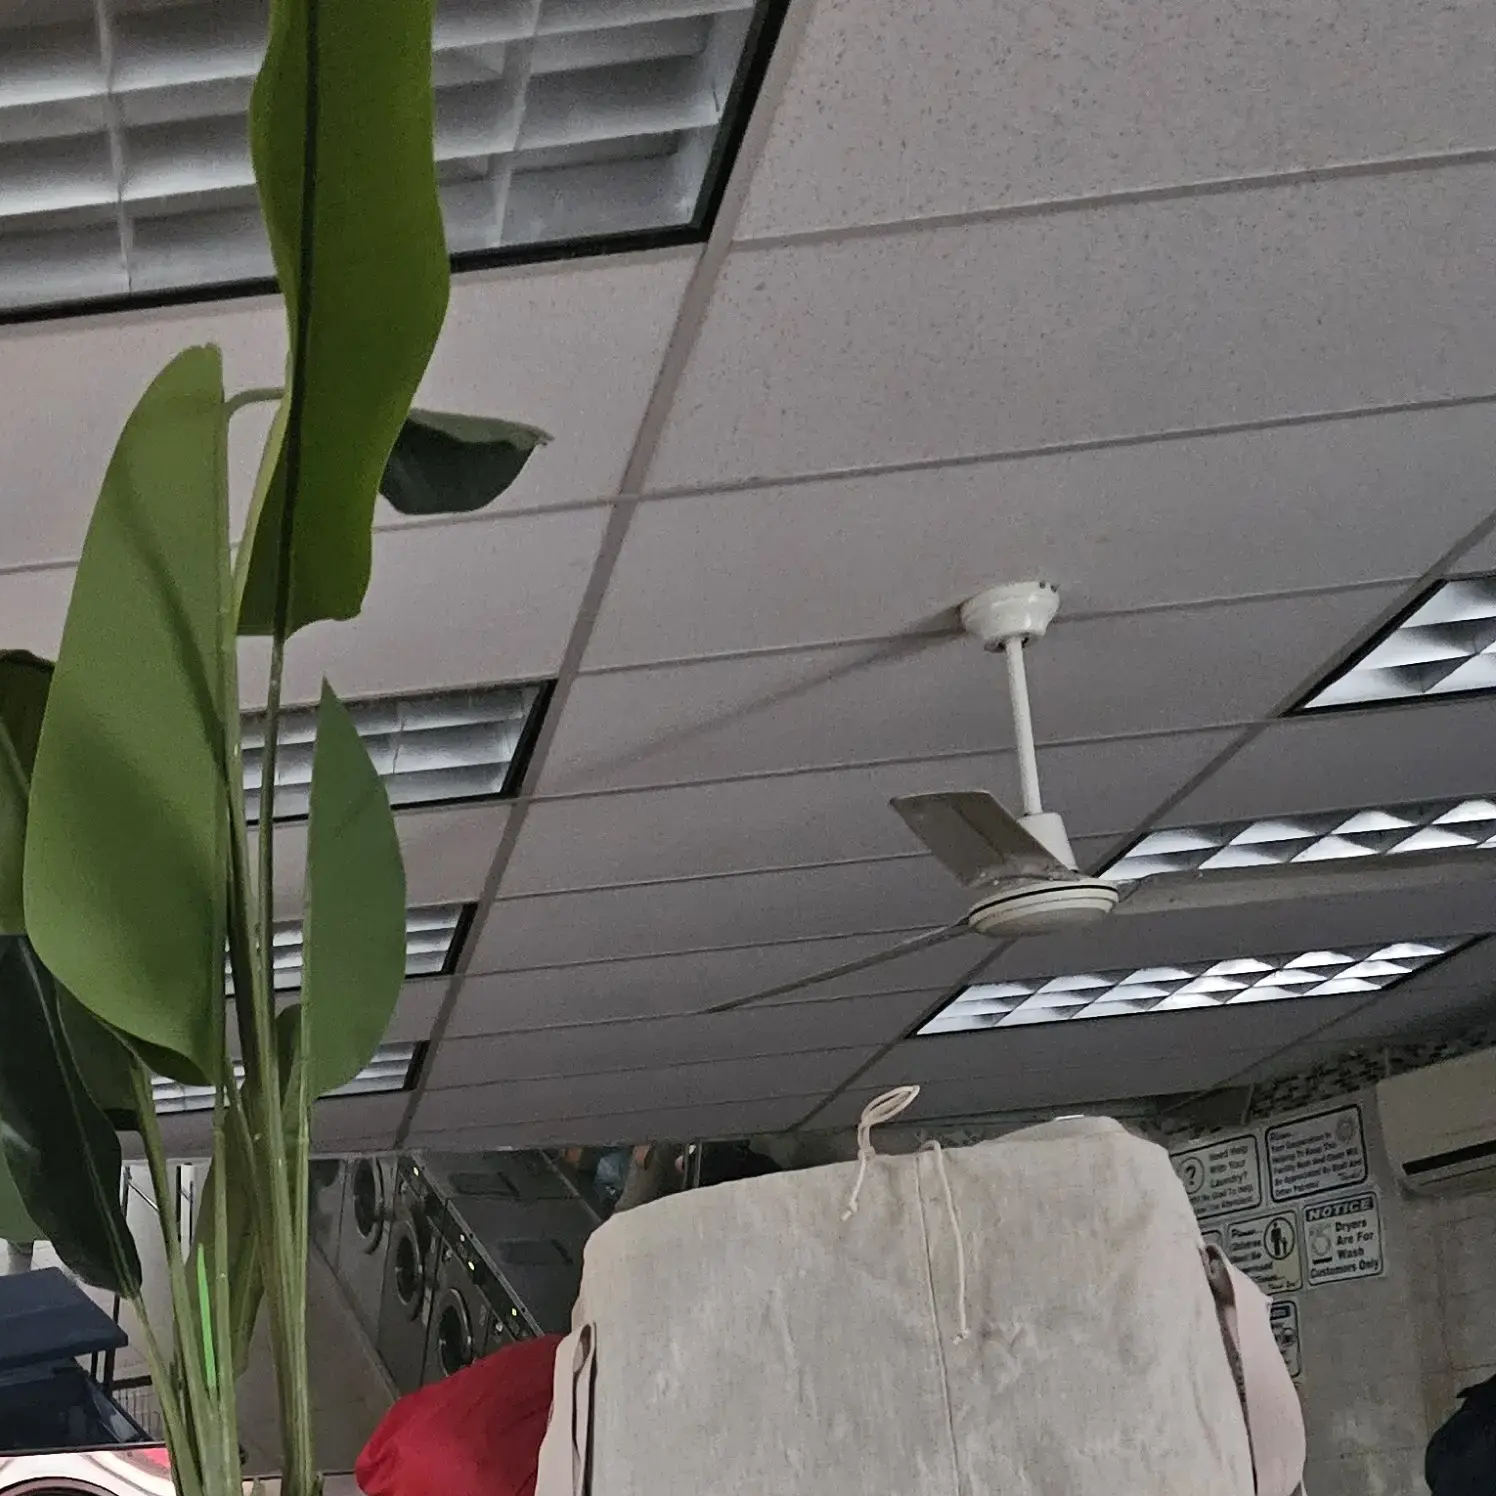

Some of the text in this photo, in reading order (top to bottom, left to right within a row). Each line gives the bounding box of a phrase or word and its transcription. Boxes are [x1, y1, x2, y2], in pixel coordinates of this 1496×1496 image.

[1307, 1197, 1373, 1221] NOTICE
[1335, 1219, 1367, 1233] Dryers
[1336, 1231, 1374, 1246] Are For
[1338, 1247, 1364, 1260] Wash
[1310, 1259, 1379, 1279] Customers Only
